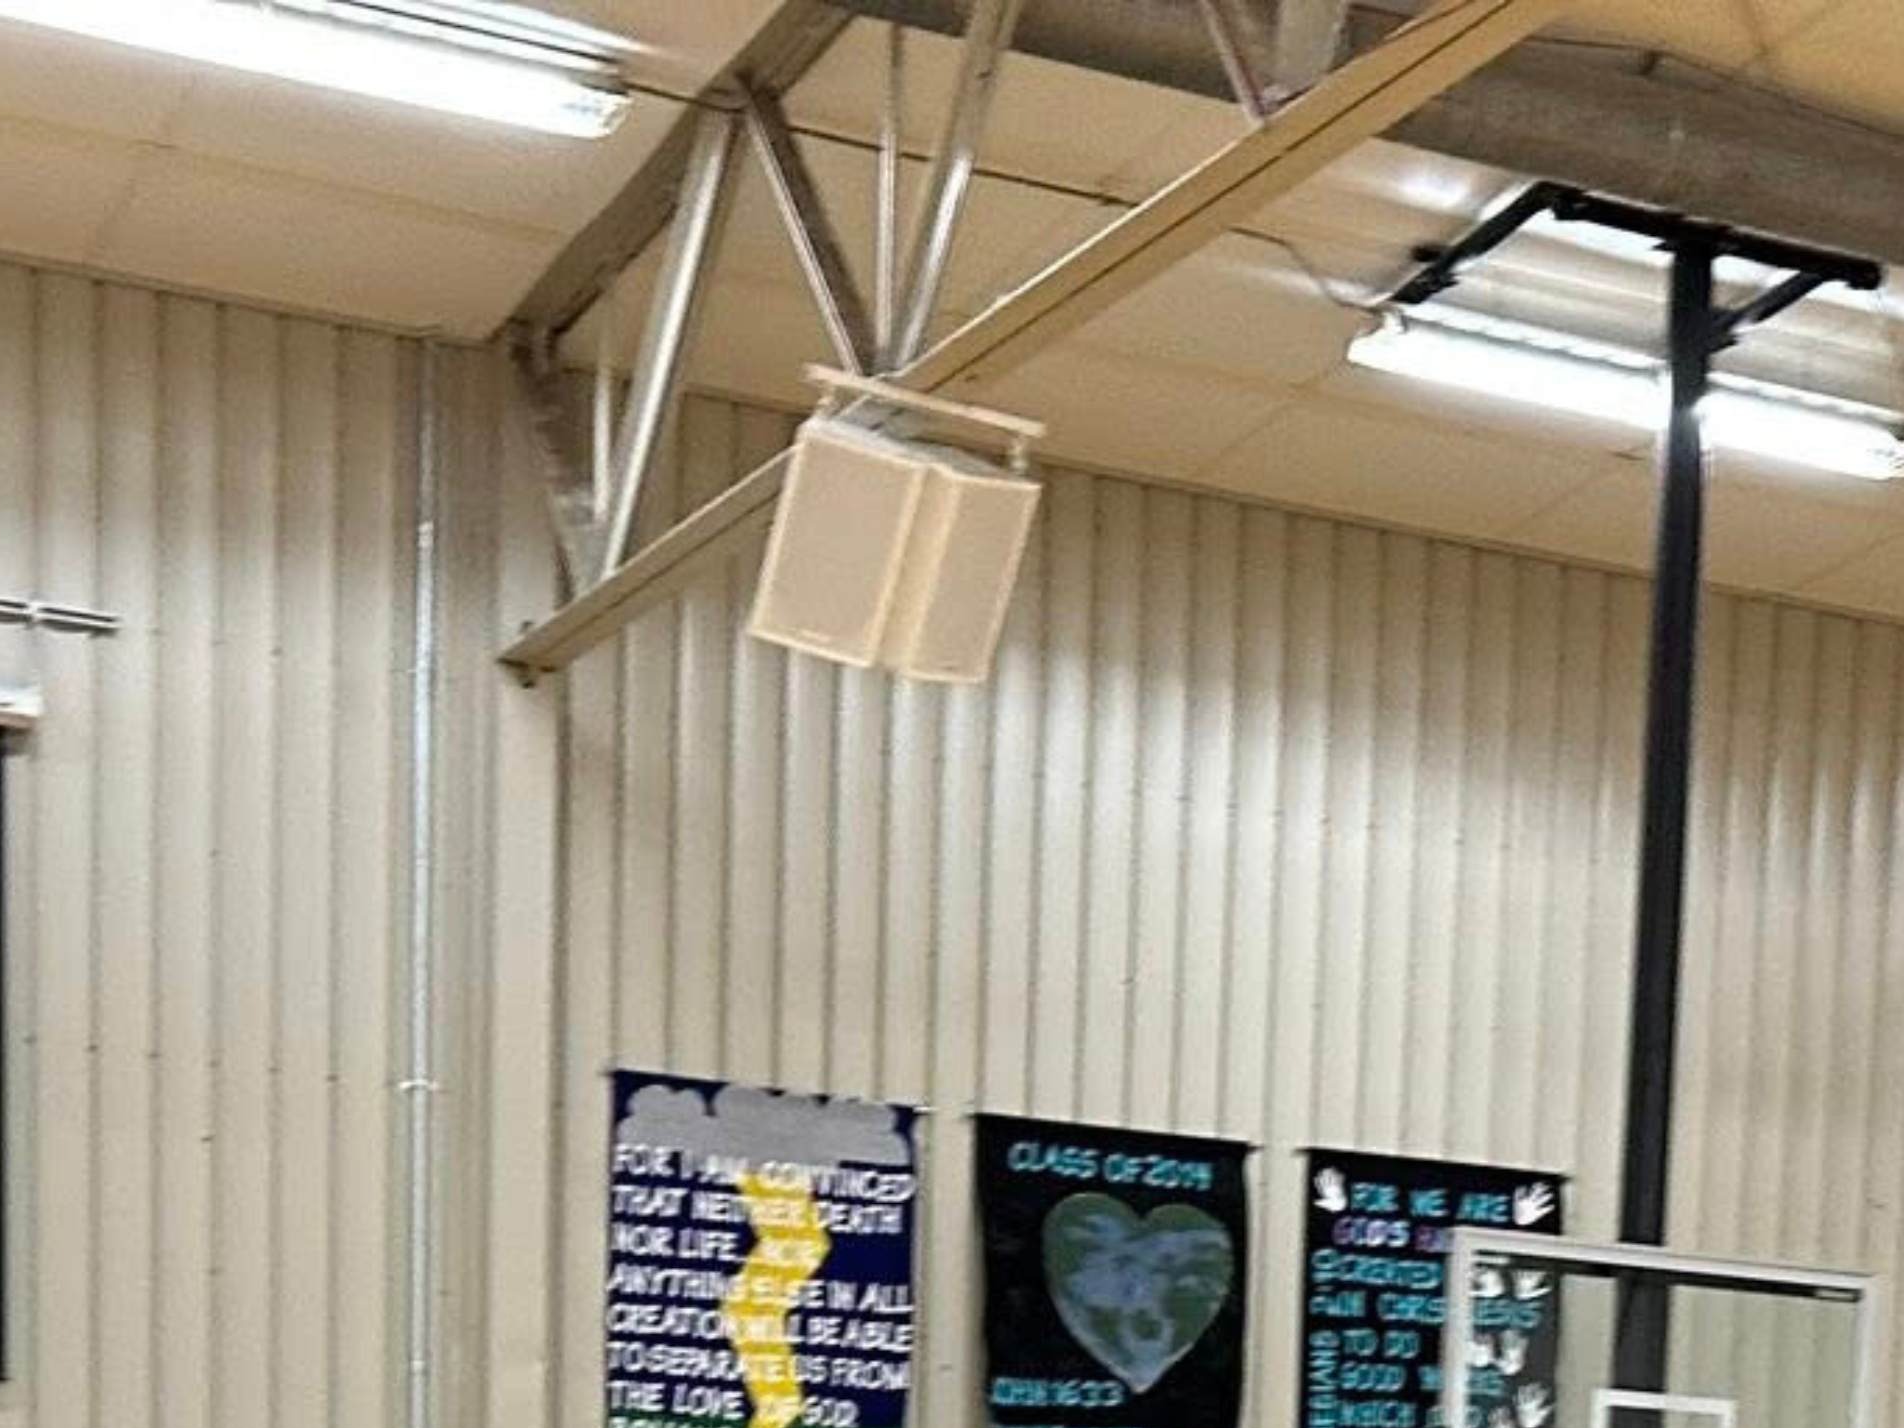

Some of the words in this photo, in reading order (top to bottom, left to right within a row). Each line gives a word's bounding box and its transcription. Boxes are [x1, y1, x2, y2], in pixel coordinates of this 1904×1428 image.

[612, 1146, 676, 1176] FOR
[1006, 1141, 1099, 1179] CLASS
[1102, 1153, 1143, 1183] OF
[612, 1184, 688, 1217] THAT
[812, 1201, 903, 1233] DEATH
[1349, 1180, 1400, 1213] FOR
[1456, 1191, 1511, 1223] ARE
[612, 1223, 674, 1255] NOR
[608, 1262, 739, 1300] ANYTHING
[859, 1282, 916, 1313] ALL
[608, 1302, 726, 1340] CREATION
[807, 1316, 842, 1347] BE
[843, 1318, 914, 1352] ABLE
[608, 1341, 645, 1372] TO
[646, 1344, 790, 1382] SEPARATE
[829, 1356, 911, 1390] FROM
[608, 1380, 665, 1412] THE
[672, 1383, 745, 1420] LOVE
